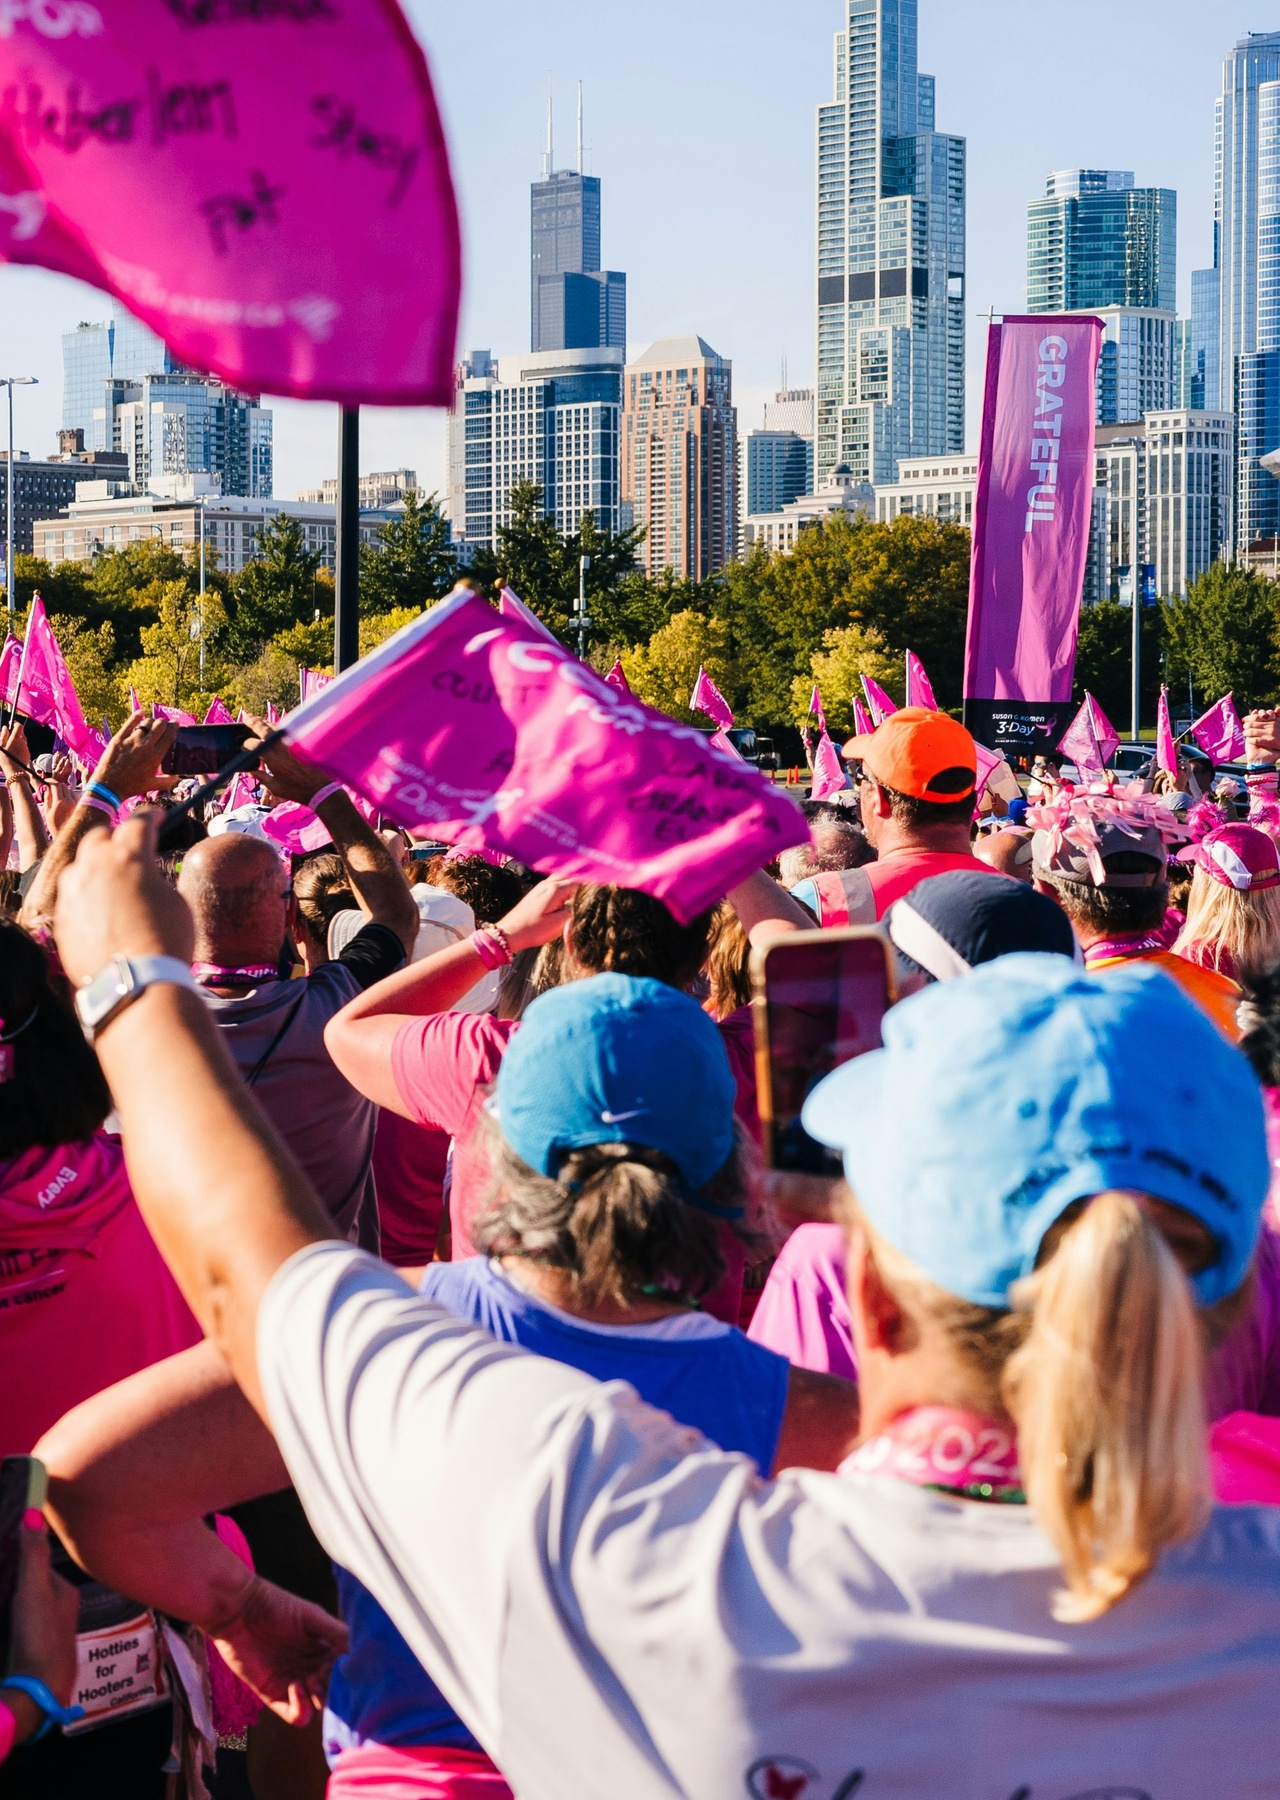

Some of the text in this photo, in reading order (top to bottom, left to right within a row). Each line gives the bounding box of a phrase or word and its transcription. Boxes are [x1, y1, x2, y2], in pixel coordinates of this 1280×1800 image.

[1025, 335, 1068, 533] GRATEFUL
[37, 1166, 78, 1209] Every
[13, 1282, 67, 1305] cancer
[88, 1638, 140, 1663] Hotties
[95, 1663, 117, 1679] for
[78, 1676, 134, 1703] Hooters
